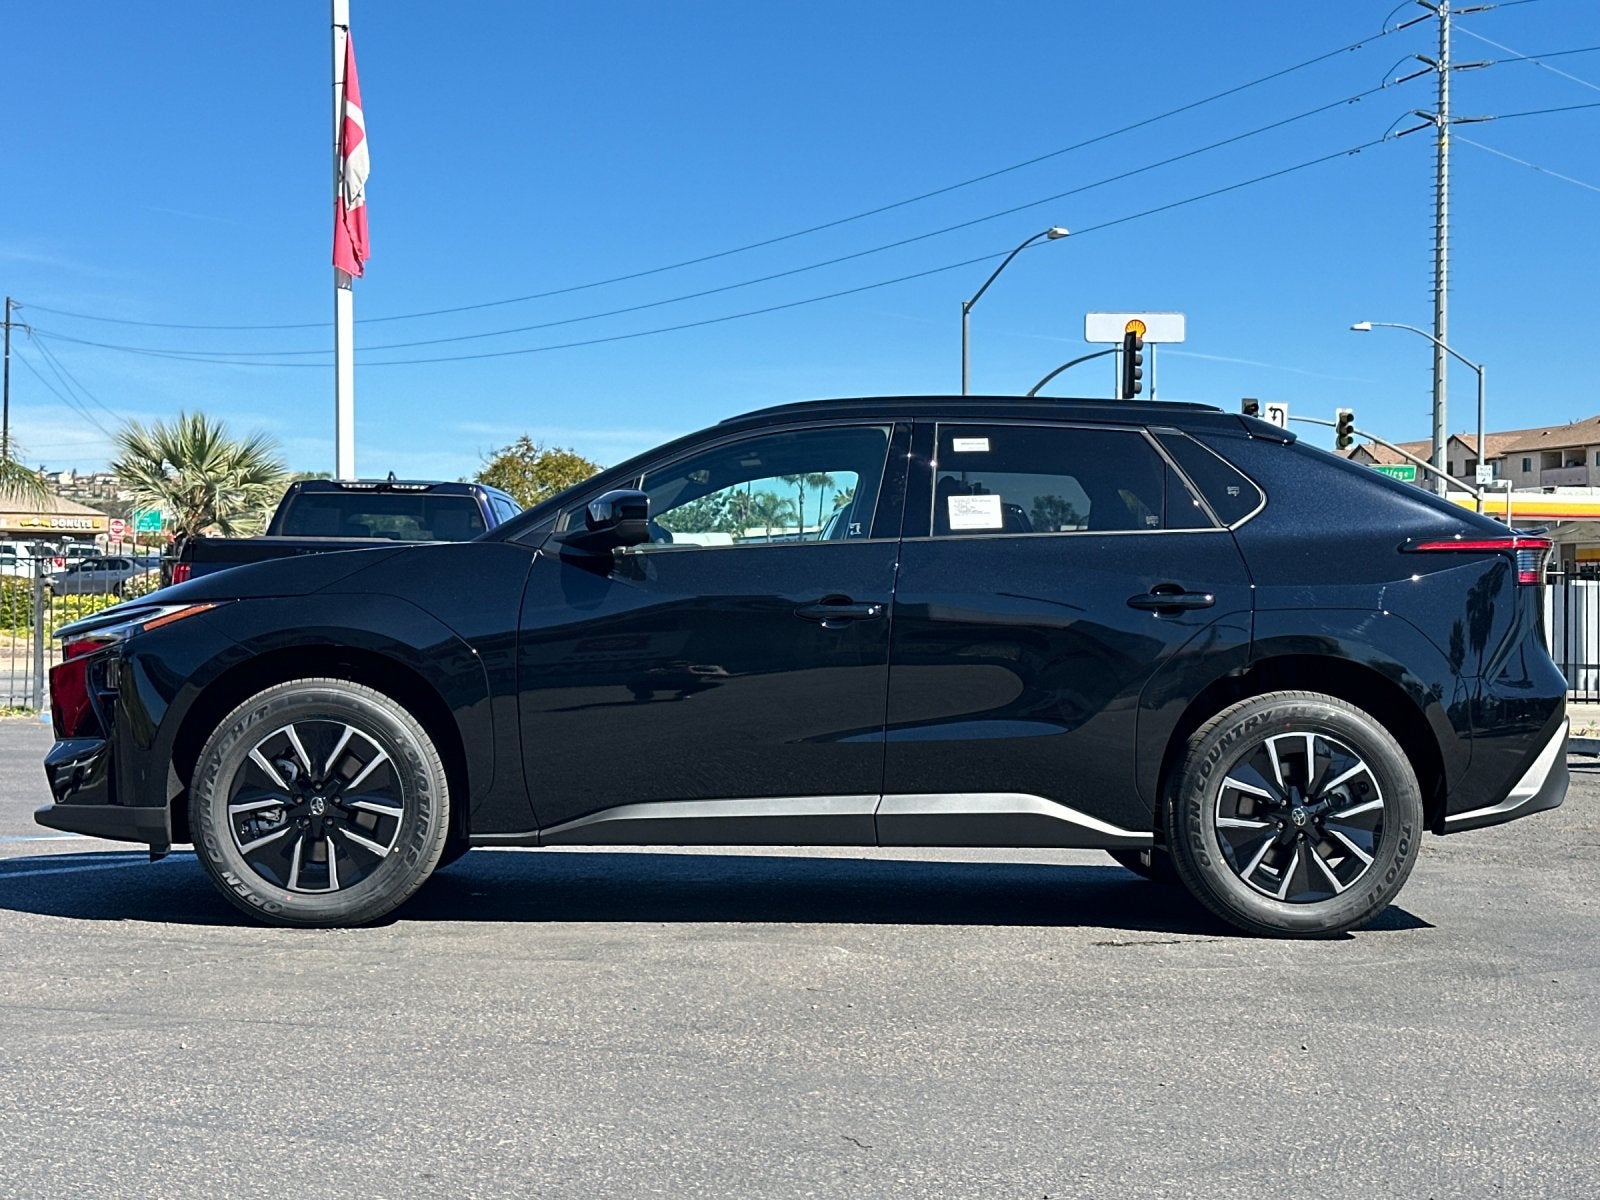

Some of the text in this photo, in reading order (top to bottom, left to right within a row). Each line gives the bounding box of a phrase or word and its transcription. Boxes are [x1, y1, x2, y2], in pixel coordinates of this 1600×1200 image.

[50, 518, 92, 529] DONUTS
[200, 752, 224, 863] COUNTRY
[1188, 710, 1273, 867] OPEN COUNTRY
[1386, 824, 1412, 882] TOYO
[221, 871, 283, 914] OPEN
